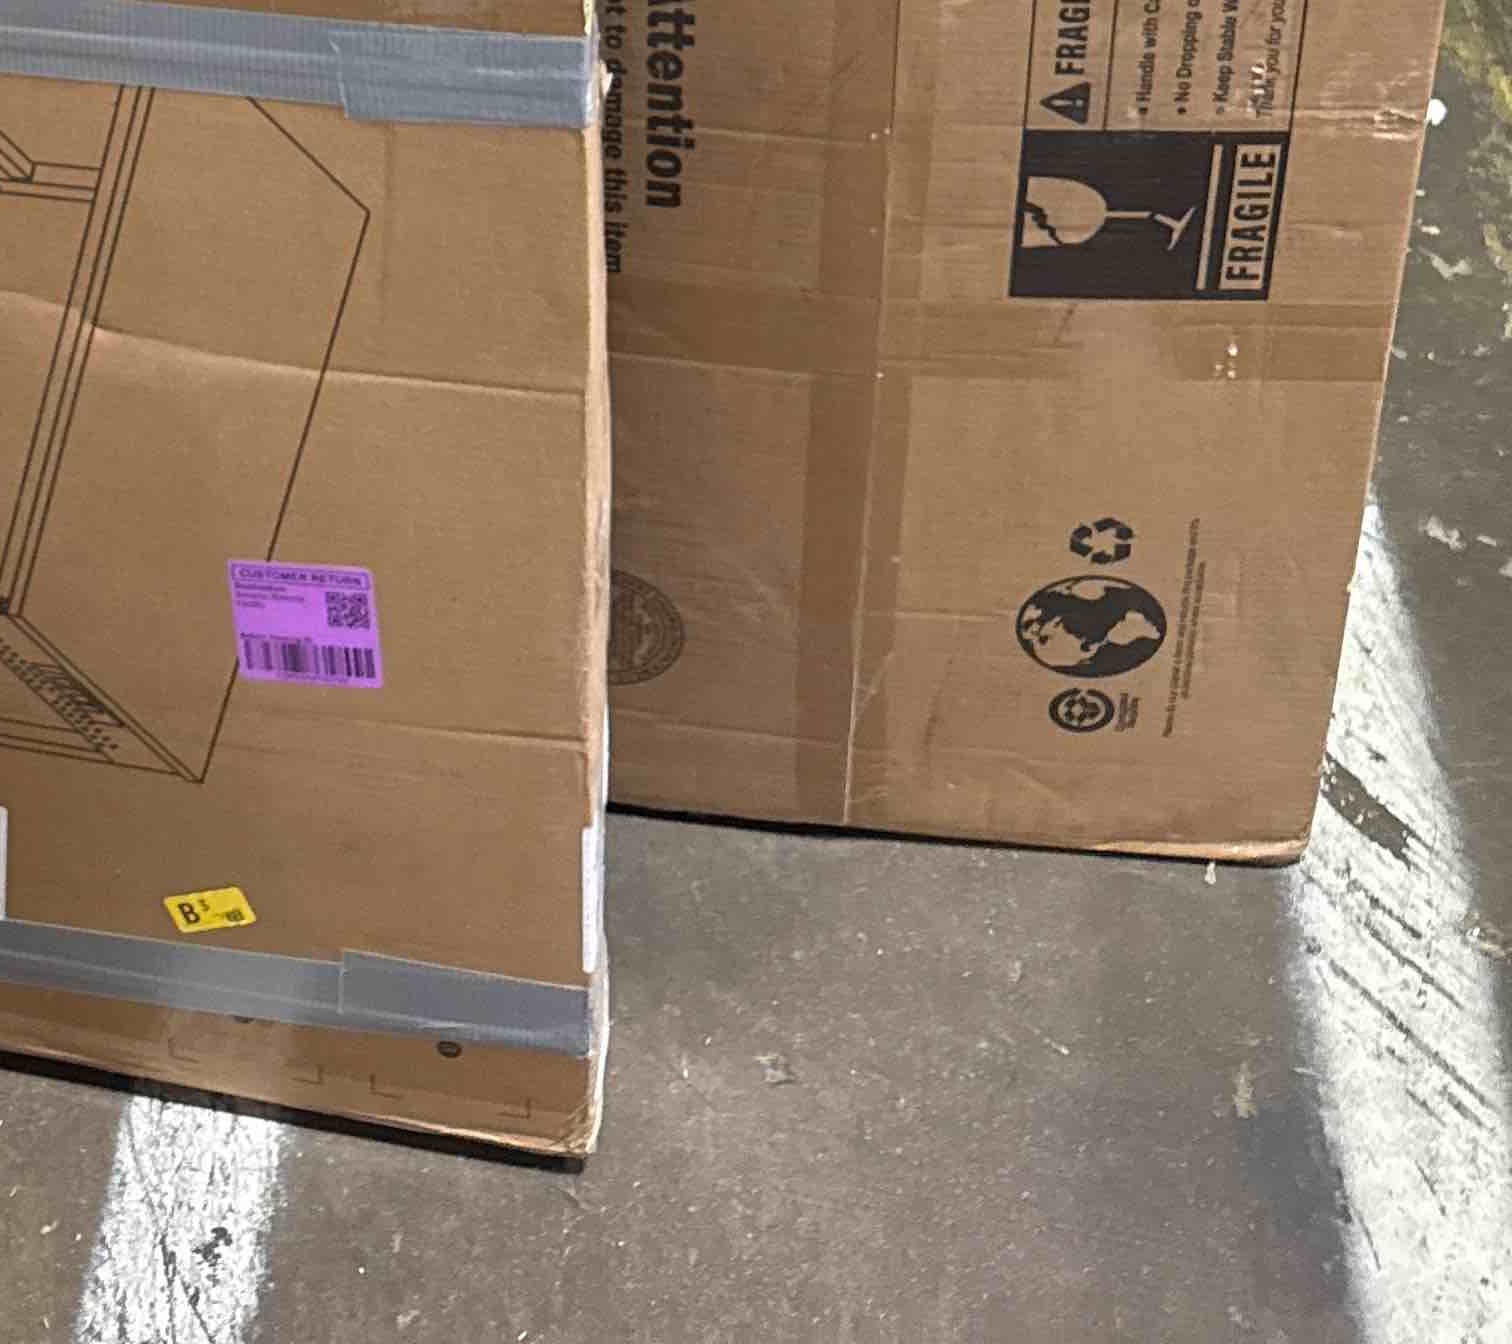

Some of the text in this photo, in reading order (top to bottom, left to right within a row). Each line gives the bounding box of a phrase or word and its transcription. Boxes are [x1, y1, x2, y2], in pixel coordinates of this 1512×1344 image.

[604, 25, 628, 55] to
[1140, 17, 1158, 49] with
[1175, 10, 1202, 79] Dropping
[1216, 16, 1238, 62] Stable
[1264, 26, 1282, 46] for
[1134, 52, 1157, 103] Handle
[1264, 47, 1283, 74] you
[1174, 81, 1191, 103] No
[1213, 65, 1235, 103] Keep
[603, 58, 629, 162] damage
[602, 165, 630, 216] this
[1225, 150, 1278, 282] FRAGILE
[602, 220, 630, 275] item
[238, 568, 362, 586] CUSTOMER RETURN
[177, 902, 201, 925] B
